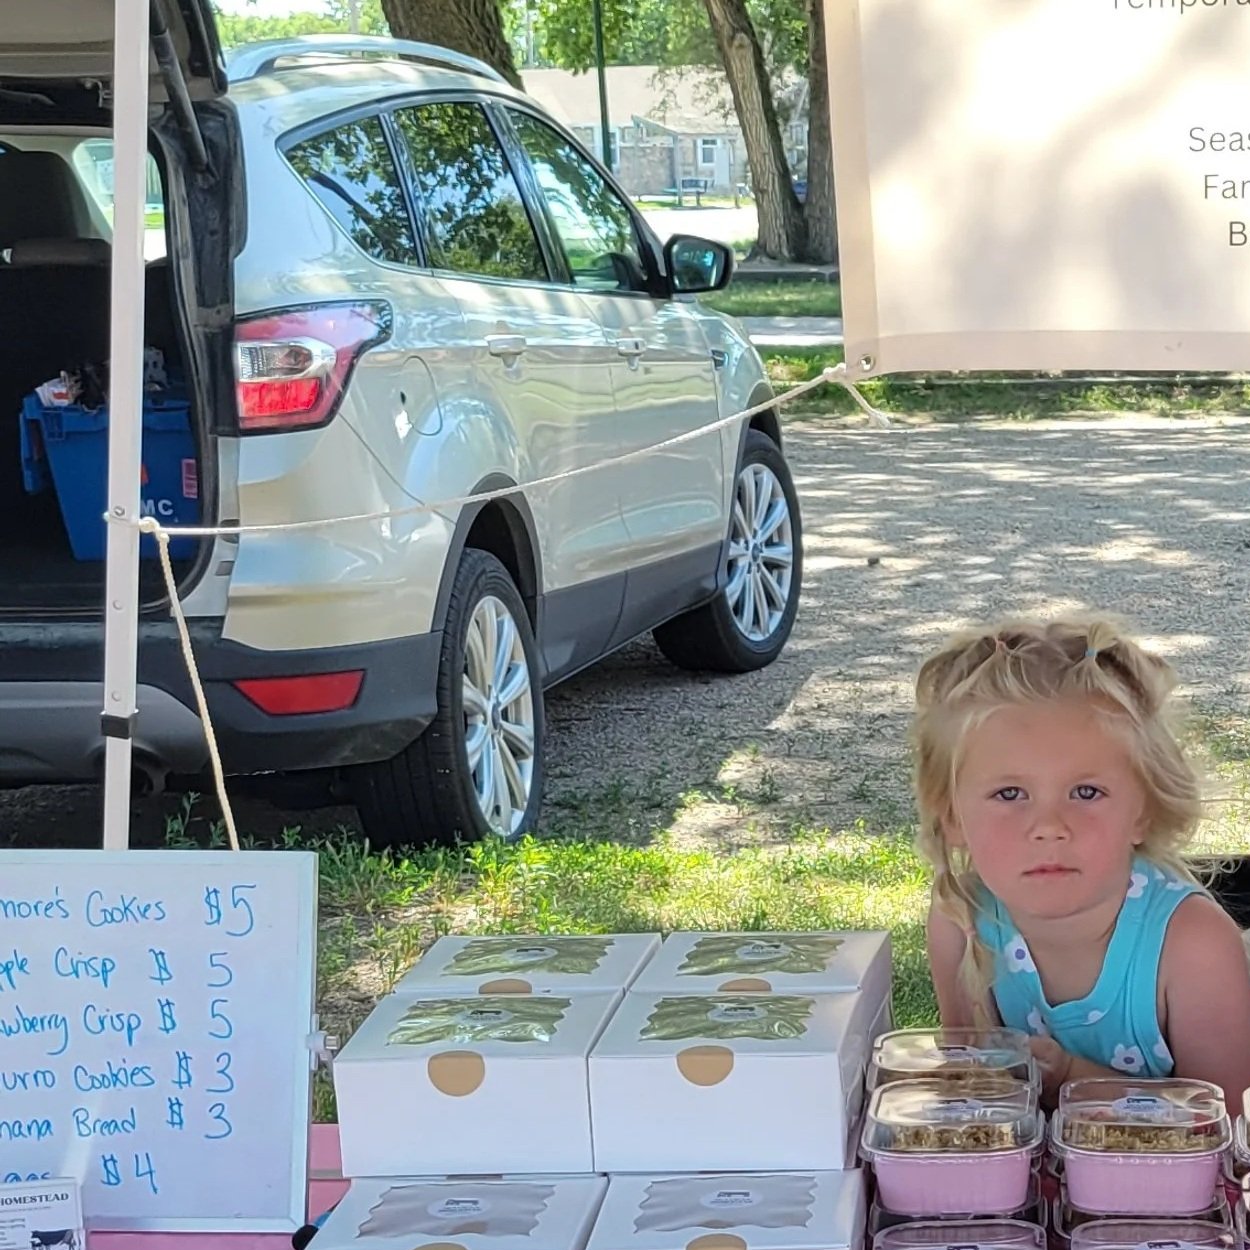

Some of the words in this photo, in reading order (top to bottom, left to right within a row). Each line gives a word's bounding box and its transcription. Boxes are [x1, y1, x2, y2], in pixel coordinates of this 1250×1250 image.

[86, 890, 166, 927] Cookies
[55, 946, 116, 988] Crisp
[0, 1005, 69, 1056] wberry
[83, 1003, 142, 1047] Crisp
[74, 1058, 156, 1092] Cookies
[72, 1107, 136, 1138] Bread
